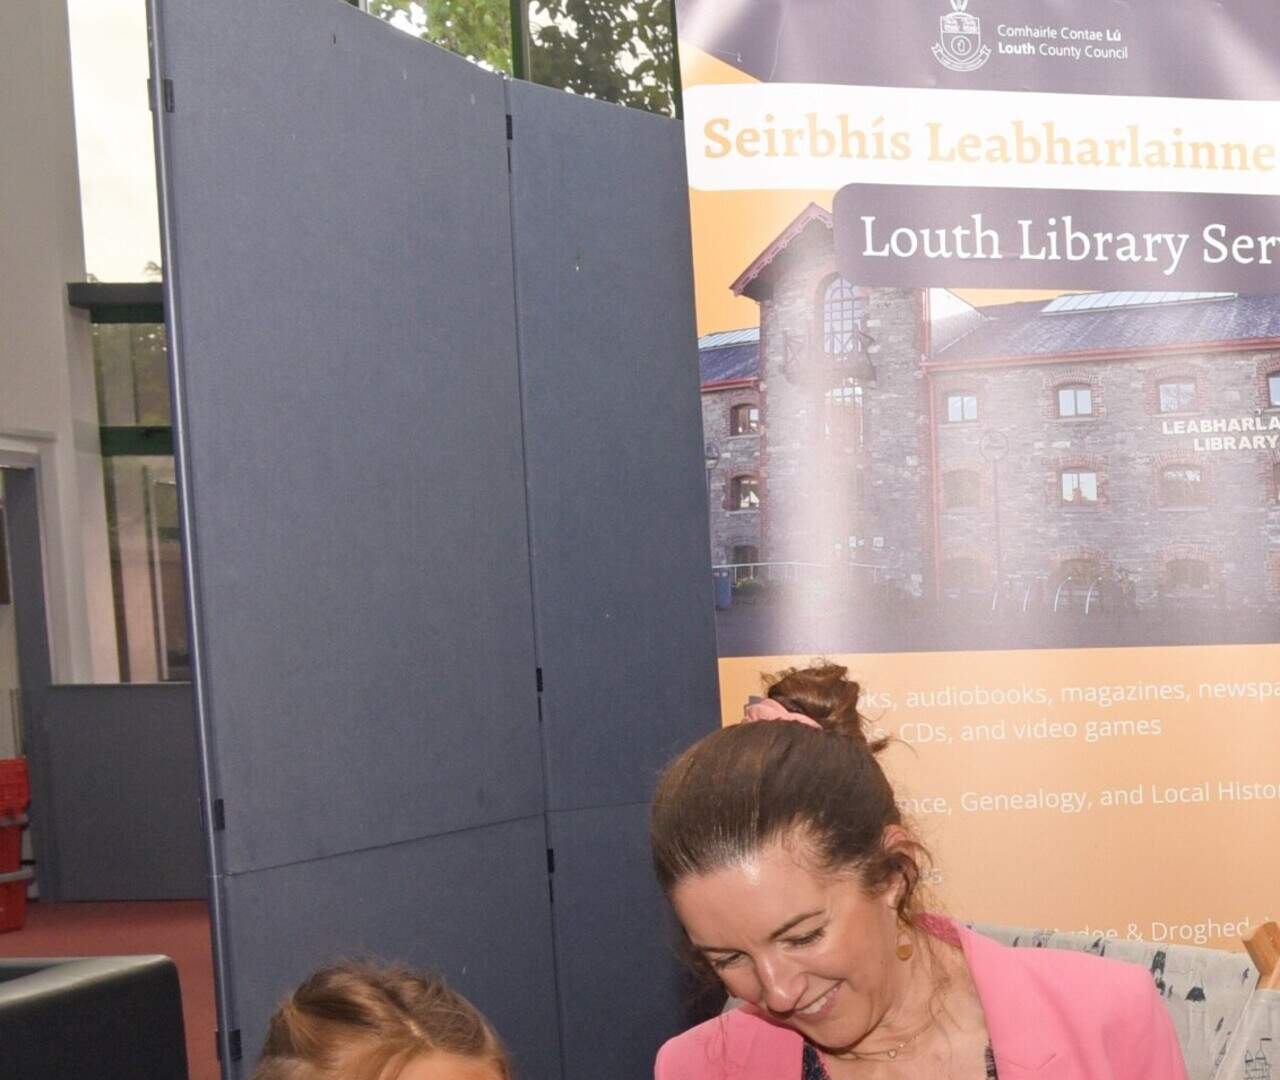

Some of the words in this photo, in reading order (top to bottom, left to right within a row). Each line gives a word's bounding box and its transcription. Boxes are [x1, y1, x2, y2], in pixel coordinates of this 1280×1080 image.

[997, 24, 1057, 39] Comhairle
[1060, 27, 1103, 41] Contae
[1106, 28, 1122, 42] Lú
[998, 42, 1036, 55] Louth
[1038, 44, 1081, 60] County
[1084, 45, 1128, 60] Council
[703, 112, 911, 160] Seirbhís
[926, 119, 1276, 175] Leabharlainne
[861, 215, 1000, 259] Louth
[1018, 218, 1190, 275] Library
[1194, 435, 1280, 452] LIBRARY
[906, 682, 1053, 708] audiobooks,
[1061, 677, 1192, 708] magazines,
[900, 722, 954, 745] CDs,
[960, 719, 1007, 741] and
[1013, 717, 1077, 739] video
[1085, 717, 1162, 743] games
[959, 783, 1094, 815] Genealogy,
[1099, 779, 1144, 806] and
[1151, 776, 1210, 805] Local
[1126, 922, 1144, 944] &
[1151, 916, 1254, 945] Droghed
